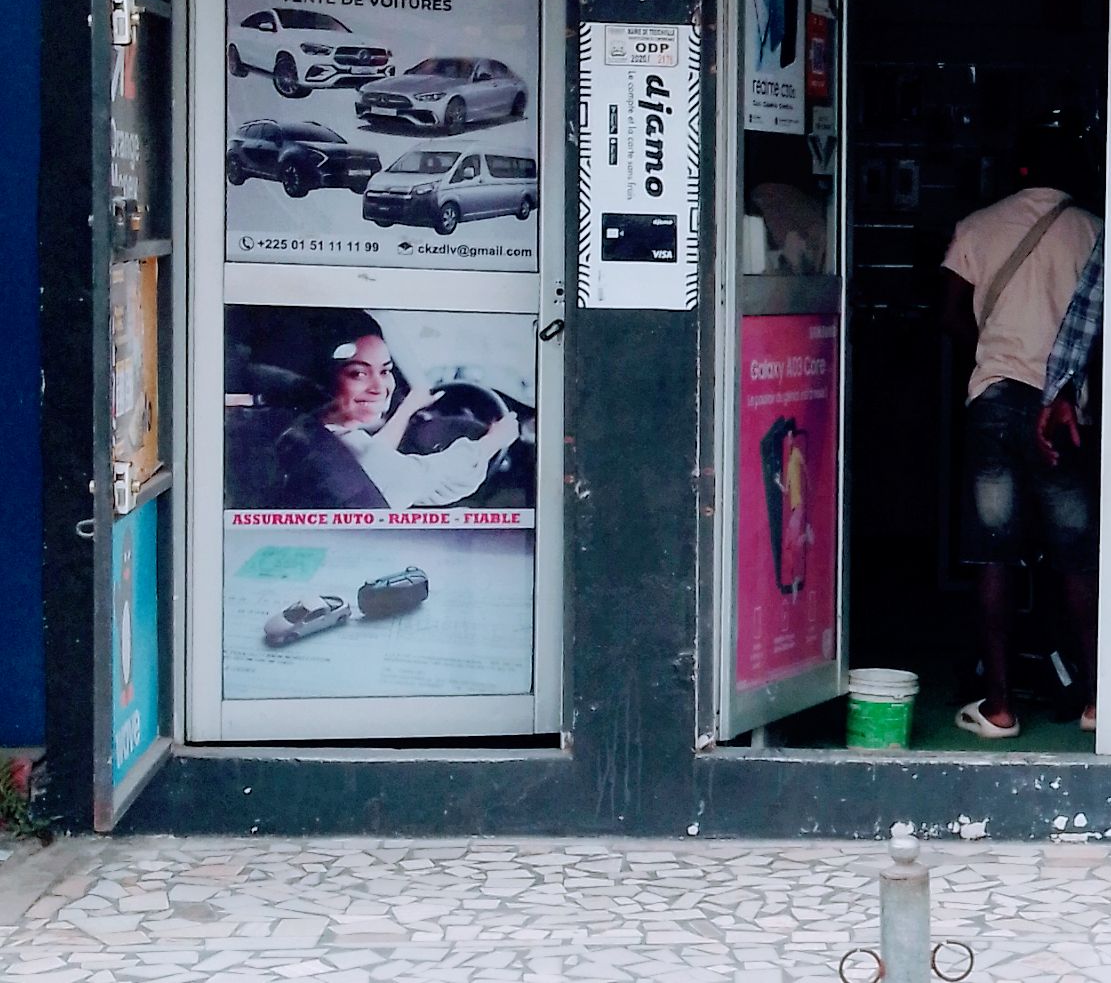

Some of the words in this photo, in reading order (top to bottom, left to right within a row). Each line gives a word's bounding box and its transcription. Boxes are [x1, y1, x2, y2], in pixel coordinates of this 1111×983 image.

[635, 41, 670, 54] ODP
[624, 82, 635, 114] compte
[638, 73, 674, 199] djamo
[257, 238, 288, 252] +225
[291, 239, 305, 252] 01
[310, 240, 323, 252] 51
[329, 241, 342, 253] 11
[348, 241, 360, 253] 11
[365, 242, 380, 254] 99
[418, 244, 533, 258] ckzdlv@gmail.com
[651, 249, 673, 259] VISA
[750, 360, 785, 385] Galaxy
[803, 355, 826, 376] Core
[232, 512, 328, 526] ASSURANCE
[332, 512, 375, 526] AUTO
[388, 513, 451, 526] RAPIDE
[463, 513, 521, 525] FIABLE
